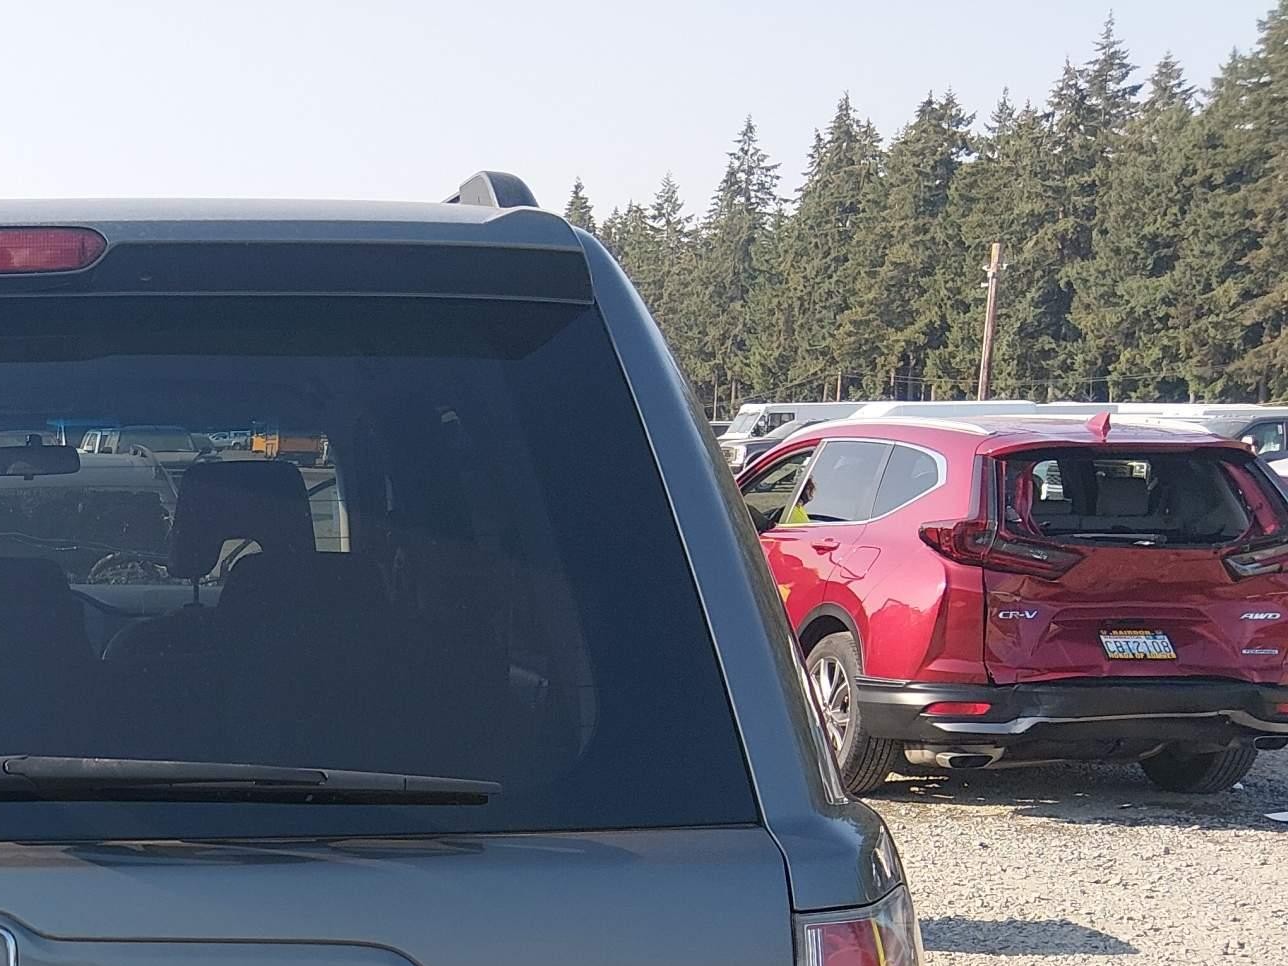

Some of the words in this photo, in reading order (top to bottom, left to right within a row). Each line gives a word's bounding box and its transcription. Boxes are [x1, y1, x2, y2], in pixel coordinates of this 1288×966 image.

[998, 610, 1038, 619] CR-V
[1240, 612, 1281, 620] AWD
[1104, 640, 1172, 654] CBT2108
